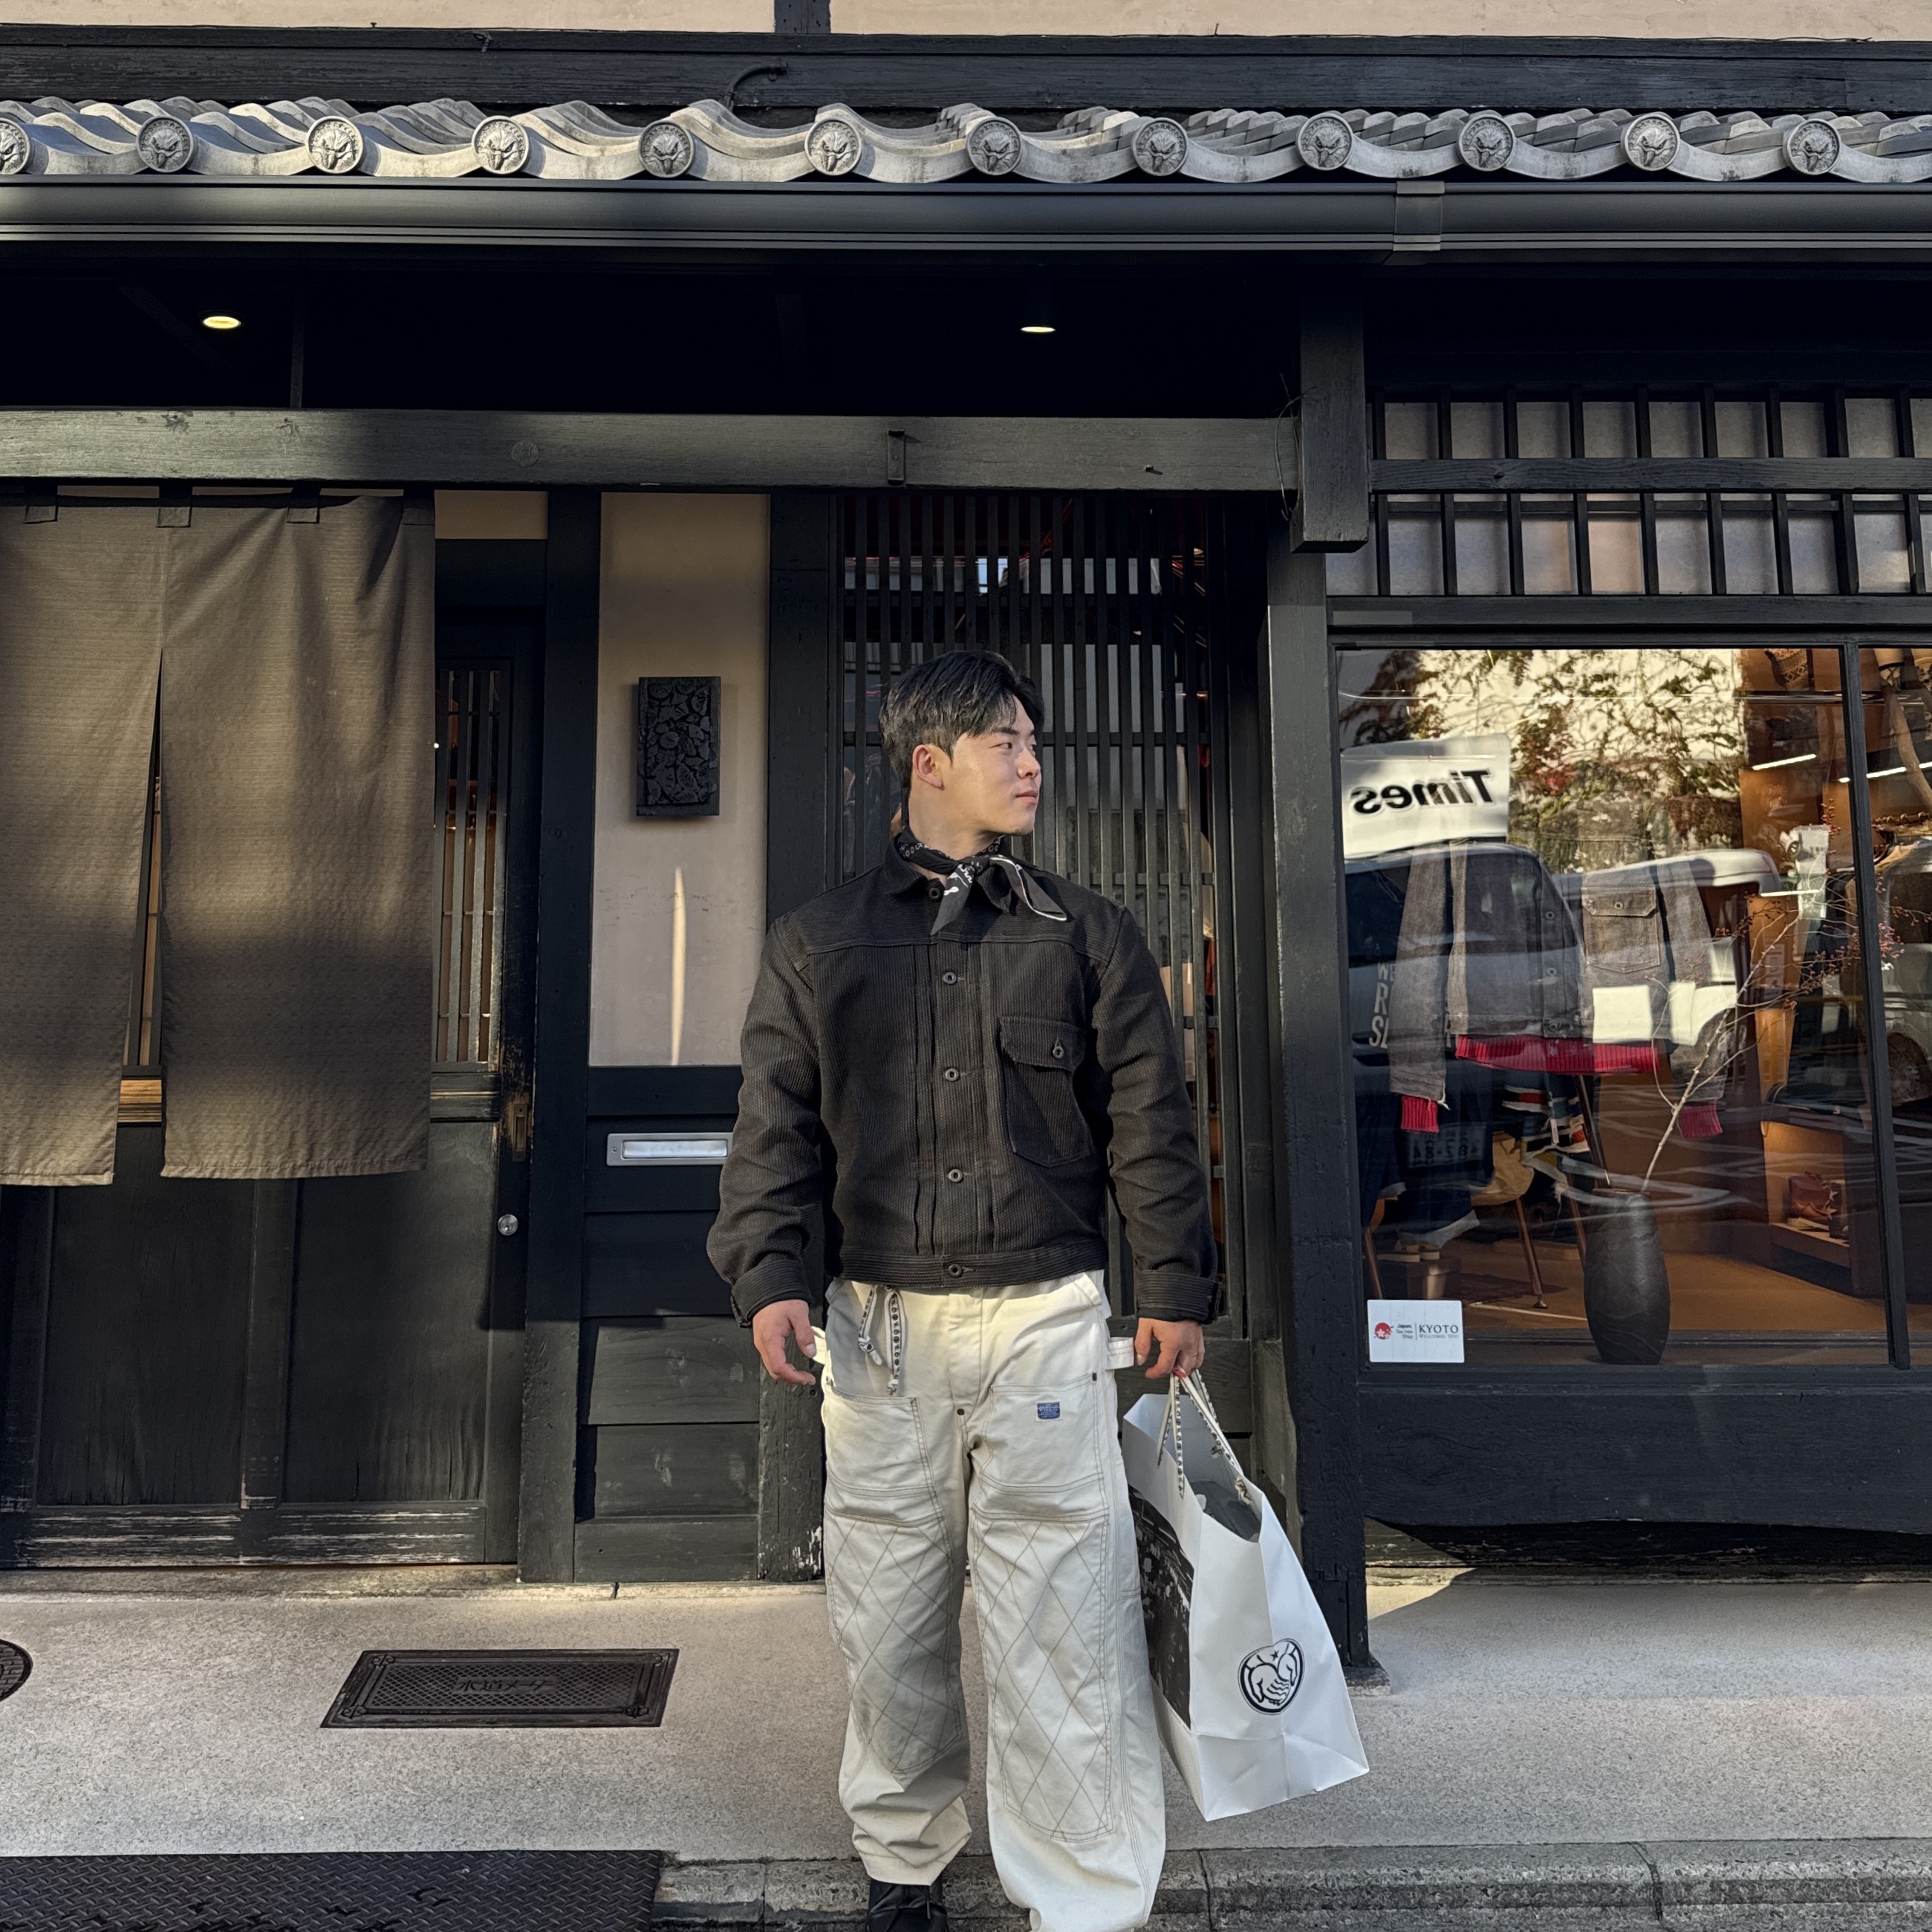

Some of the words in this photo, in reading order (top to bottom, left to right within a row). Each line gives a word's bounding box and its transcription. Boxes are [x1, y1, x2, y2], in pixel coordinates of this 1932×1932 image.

[1419, 1324, 1459, 1334] KYOTO
[458, 1679, 556, 1692] 水道メーター
